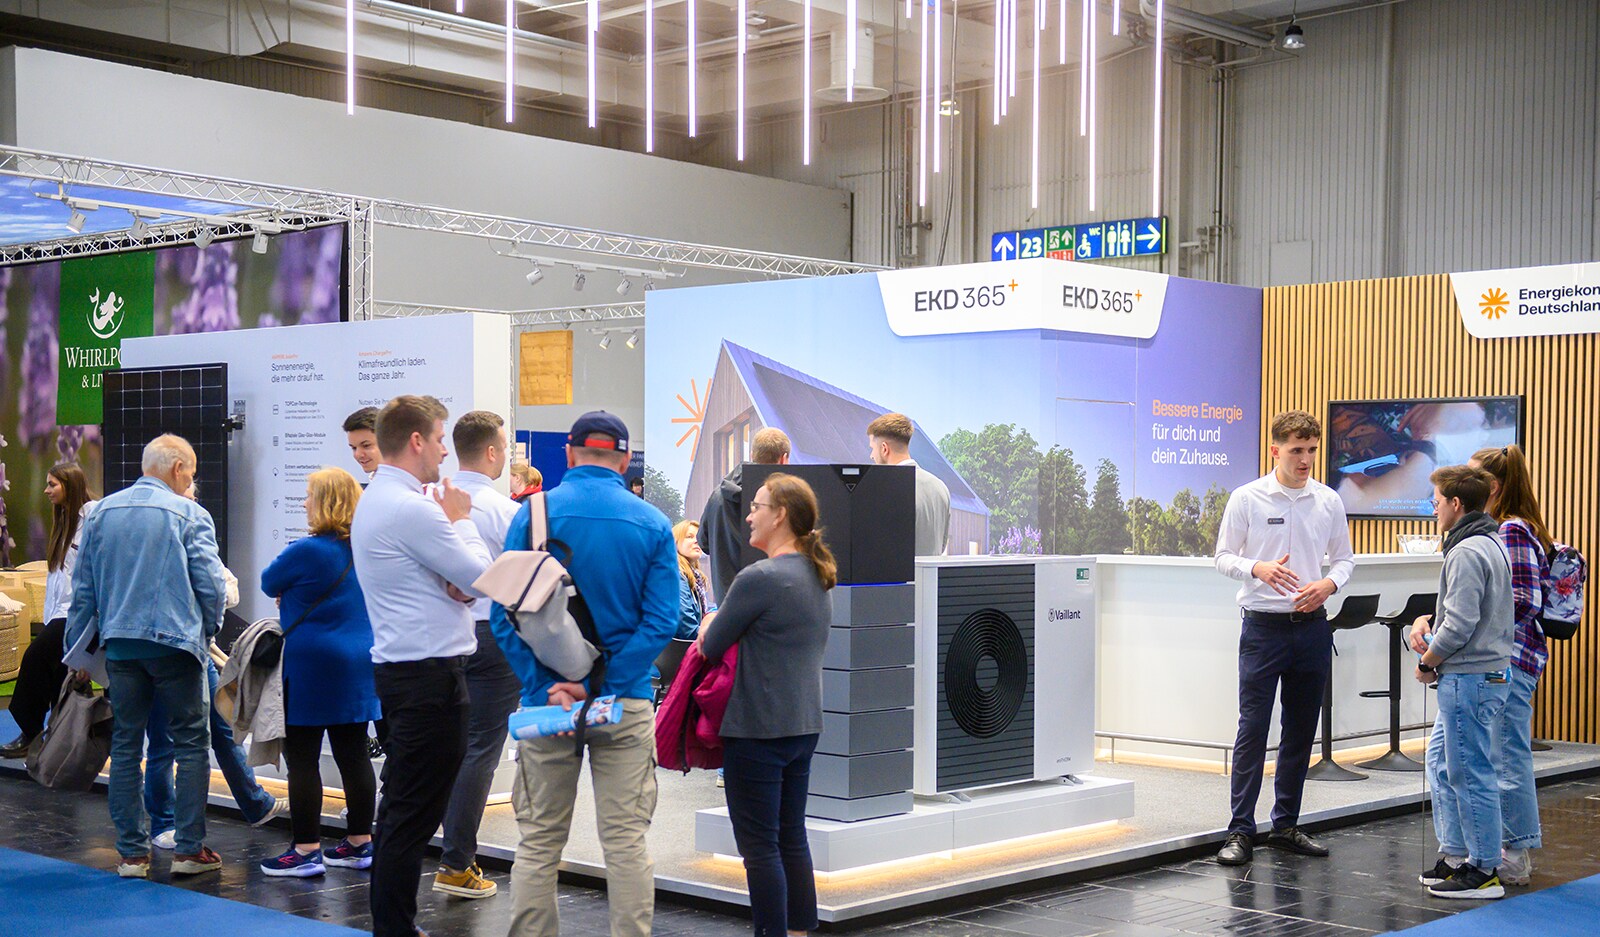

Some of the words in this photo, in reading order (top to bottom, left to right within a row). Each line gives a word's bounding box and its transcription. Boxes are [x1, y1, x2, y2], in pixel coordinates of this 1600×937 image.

[1089, 227, 1101, 236] WC
[1021, 236, 1042, 258] 23
[914, 288, 959, 312] EKD
[1063, 285, 1098, 310] EKD
[271, 362, 315, 372] Sonnenenergie,
[358, 358, 406, 369] Klimafreundlich
[407, 357, 427, 366] laden.
[81, 374, 89, 388] &
[91, 373, 103, 388] LI
[271, 374, 280, 383] die
[281, 374, 296, 382] mehr
[297, 373, 312, 381] drauf
[314, 373, 325, 381] hat.
[358, 372, 370, 381] Das
[371, 372, 390, 382] ganze
[391, 371, 406, 380] Jahr.
[1152, 399, 1198, 418] Bessere
[1201, 402, 1243, 424] Energie
[1152, 423, 1169, 440] für
[1172, 424, 1196, 441] dich
[1199, 426, 1221, 442] und
[1151, 447, 1176, 464] dein
[1179, 448, 1230, 466] Zuhause.
[1055, 609, 1081, 620] Vaillant
